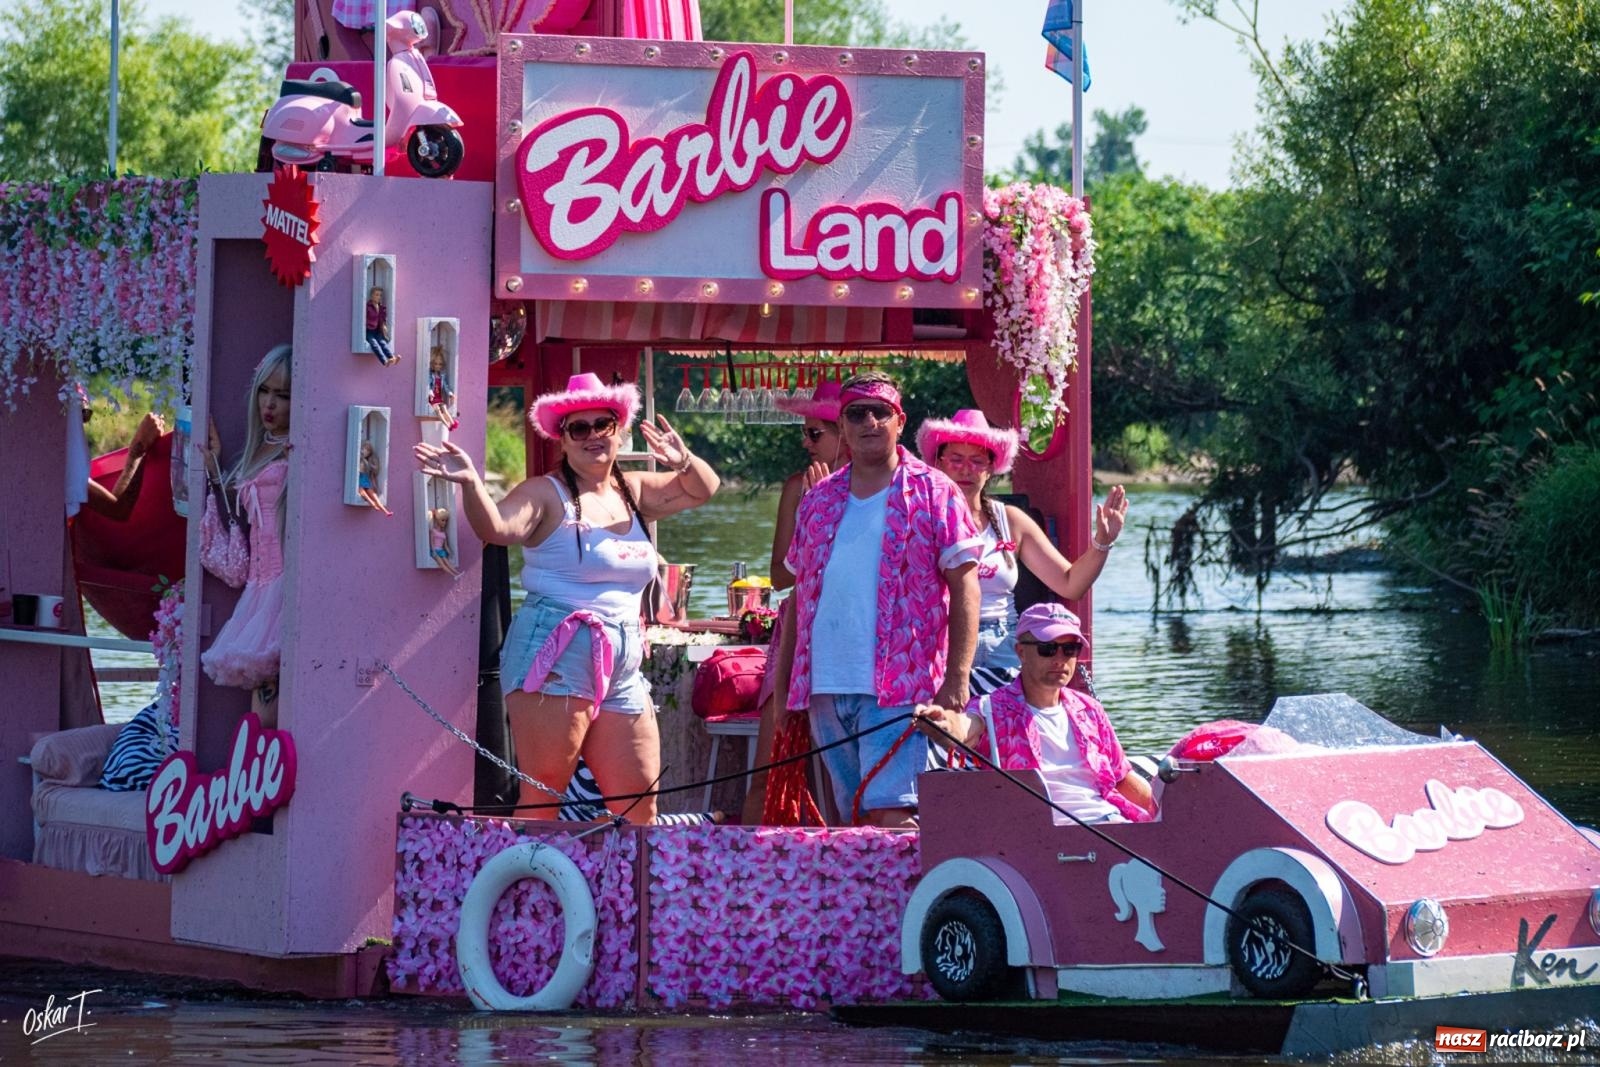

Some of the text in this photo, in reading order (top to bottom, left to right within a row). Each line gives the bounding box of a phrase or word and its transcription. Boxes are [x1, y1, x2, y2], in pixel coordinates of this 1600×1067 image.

[525, 55, 848, 251] Barbie
[266, 203, 311, 246] MATTEL
[768, 191, 958, 277] Land
[149, 719, 284, 866] Barbie
[1332, 782, 1520, 859] Barbie
[1510, 914, 1599, 986] Ken
